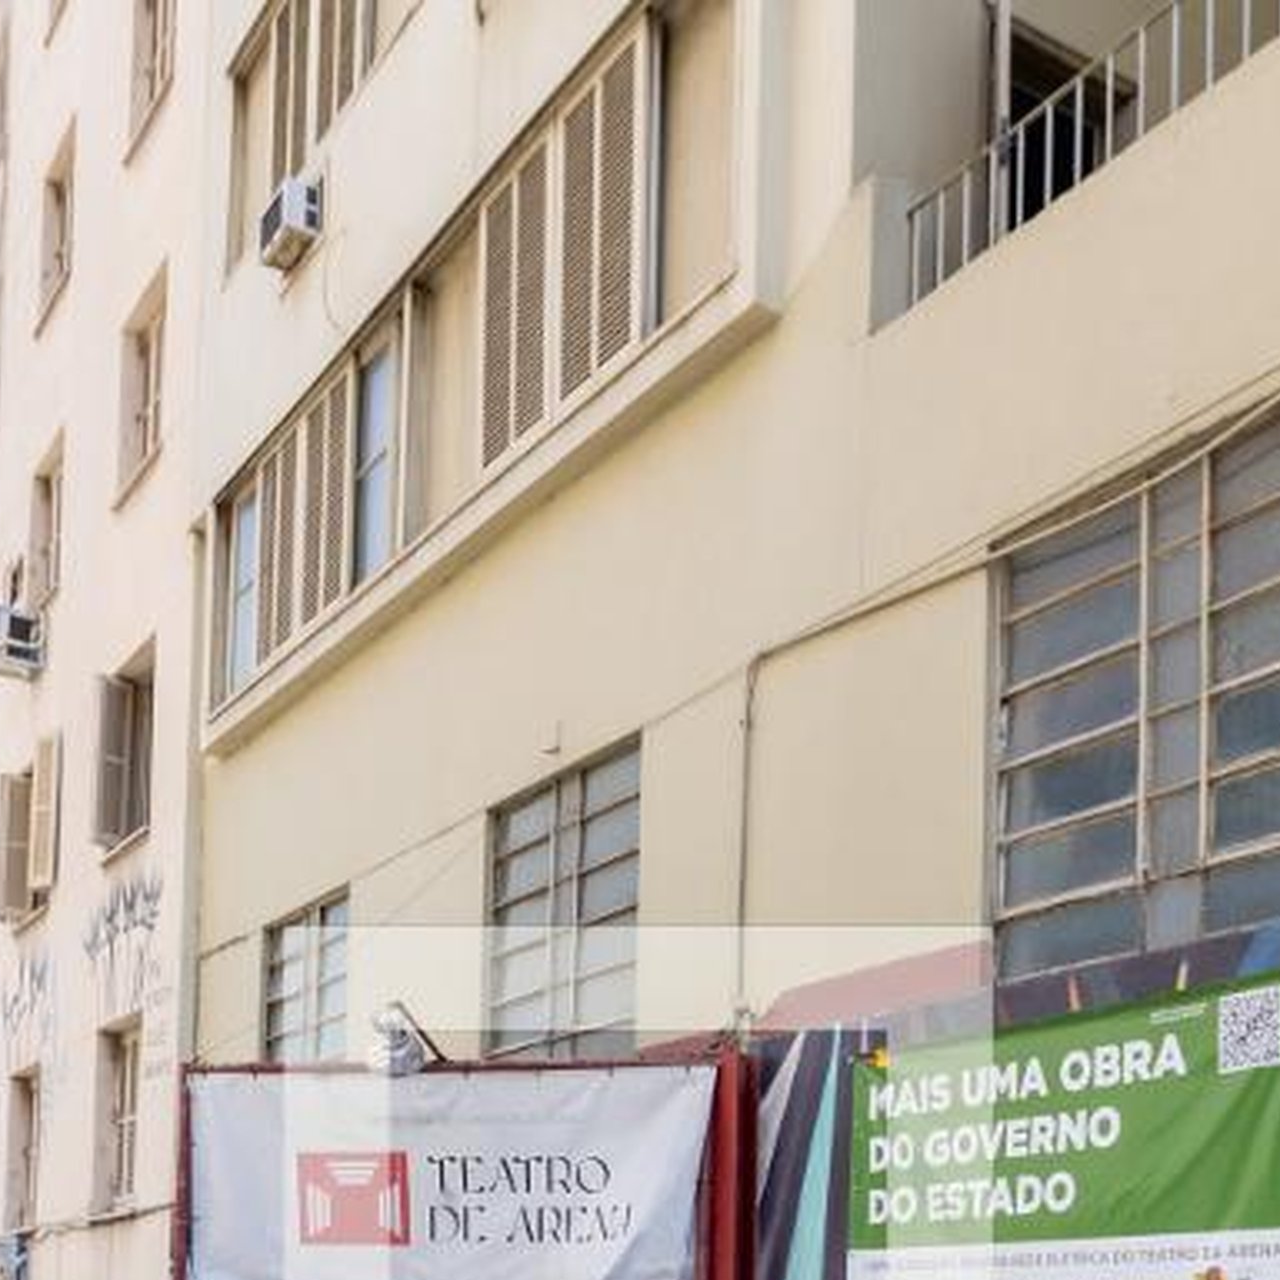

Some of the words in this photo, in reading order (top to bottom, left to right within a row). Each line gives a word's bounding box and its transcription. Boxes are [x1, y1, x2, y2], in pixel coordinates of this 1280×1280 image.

[867, 1073, 953, 1121] MAIS
[961, 1057, 1048, 1107] UMA
[1059, 1033, 1188, 1093] OBRA
[867, 1132, 915, 1173] DO
[923, 1106, 1121, 1166] GOVERNO
[426, 1154, 612, 1195] TEATRO
[867, 1187, 917, 1225] DO
[927, 1172, 1077, 1222] ESTADO
[428, 1204, 487, 1244] DE
